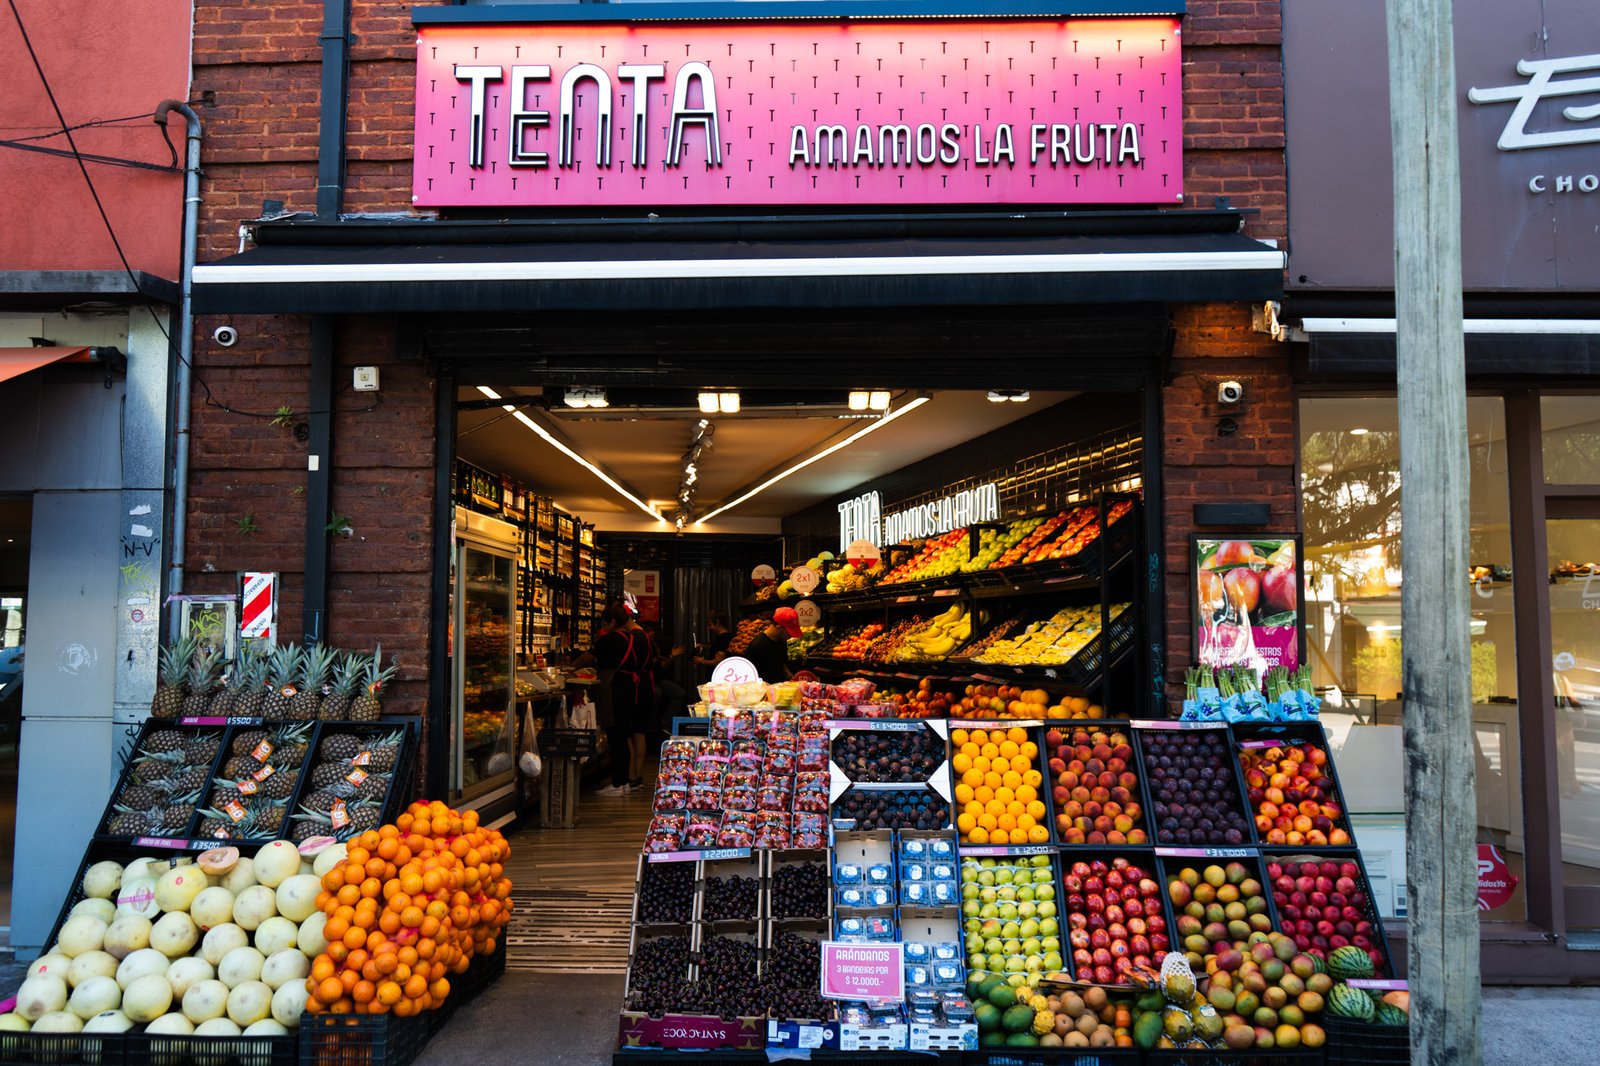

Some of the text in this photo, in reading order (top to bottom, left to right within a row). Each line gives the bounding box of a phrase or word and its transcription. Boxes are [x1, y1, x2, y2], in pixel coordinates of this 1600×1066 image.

[454, 61, 723, 168] TENTA
[788, 122, 1141, 166] AMAMOS LA FRUTA
[1529, 174, 1599, 194] CHO
[796, 573, 811, 583] 2x1
[799, 608, 813, 617] 3x2
[704, 849, 738, 859] $22000
[836, 948, 890, 962] ARÁNDANOS
[836, 964, 843, 973] 3
[876, 966, 889, 975] POR
